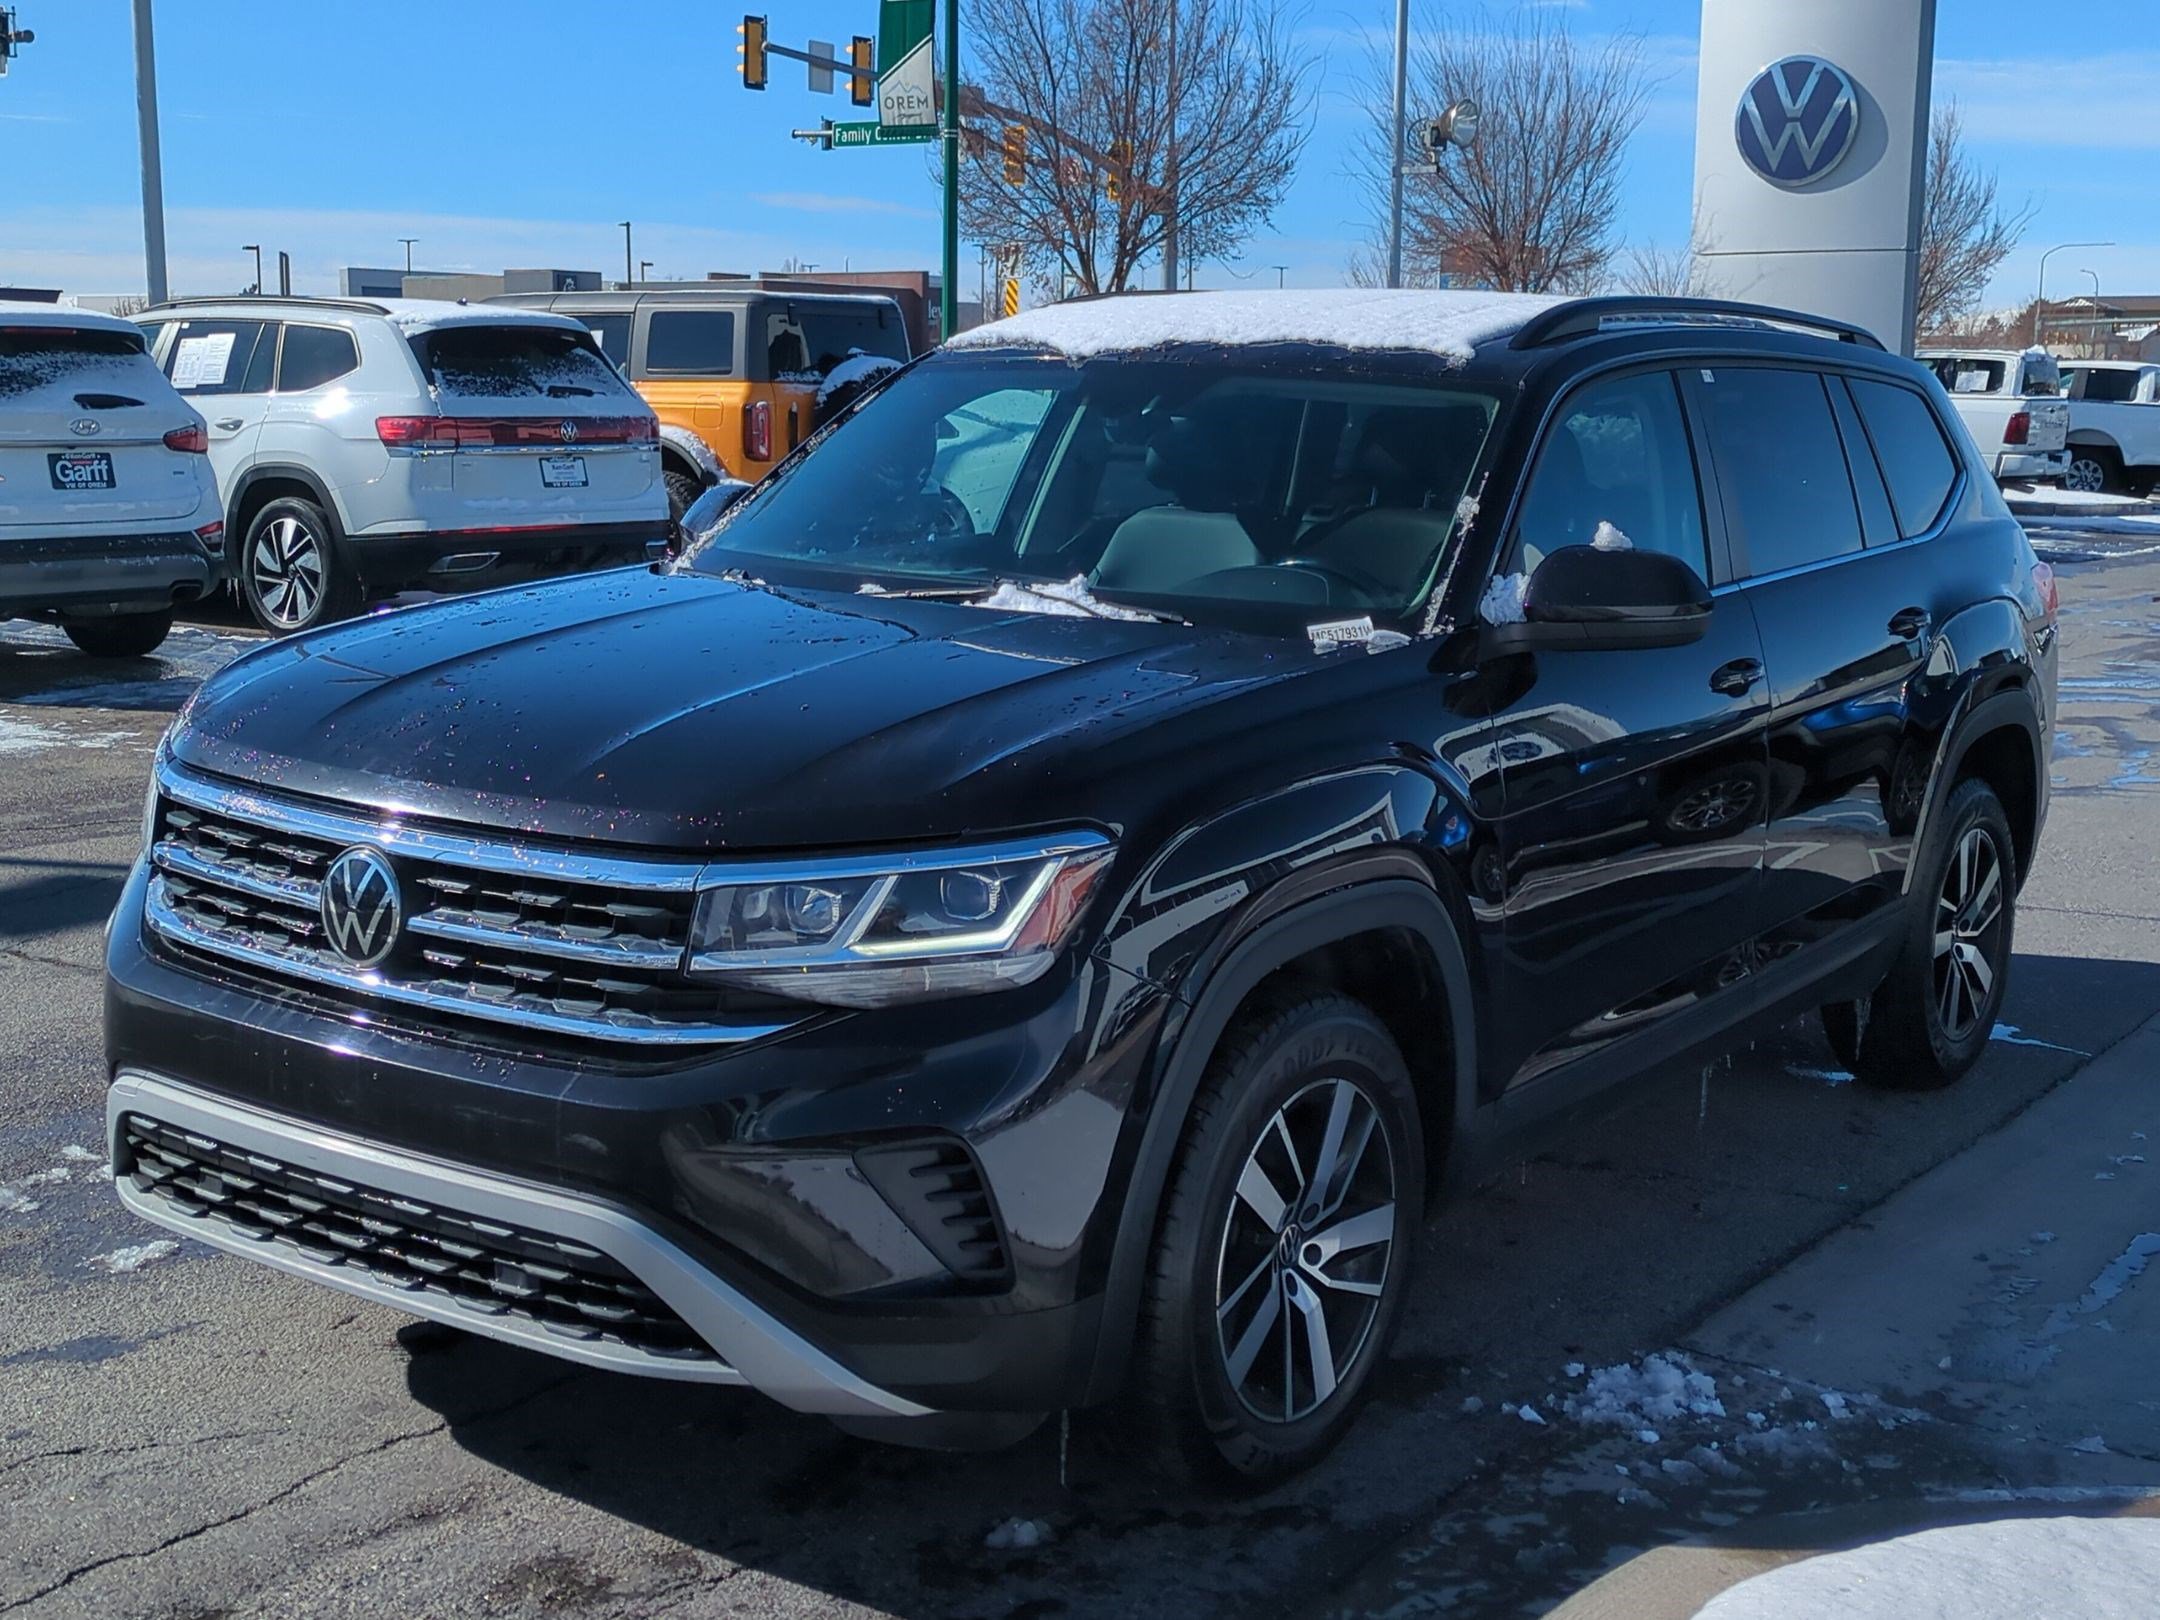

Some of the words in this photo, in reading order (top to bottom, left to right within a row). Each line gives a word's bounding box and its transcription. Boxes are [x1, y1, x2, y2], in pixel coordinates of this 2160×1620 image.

[884, 95, 929, 110] OREM
[835, 127, 872, 145] Family
[55, 460, 108, 482] Garff
